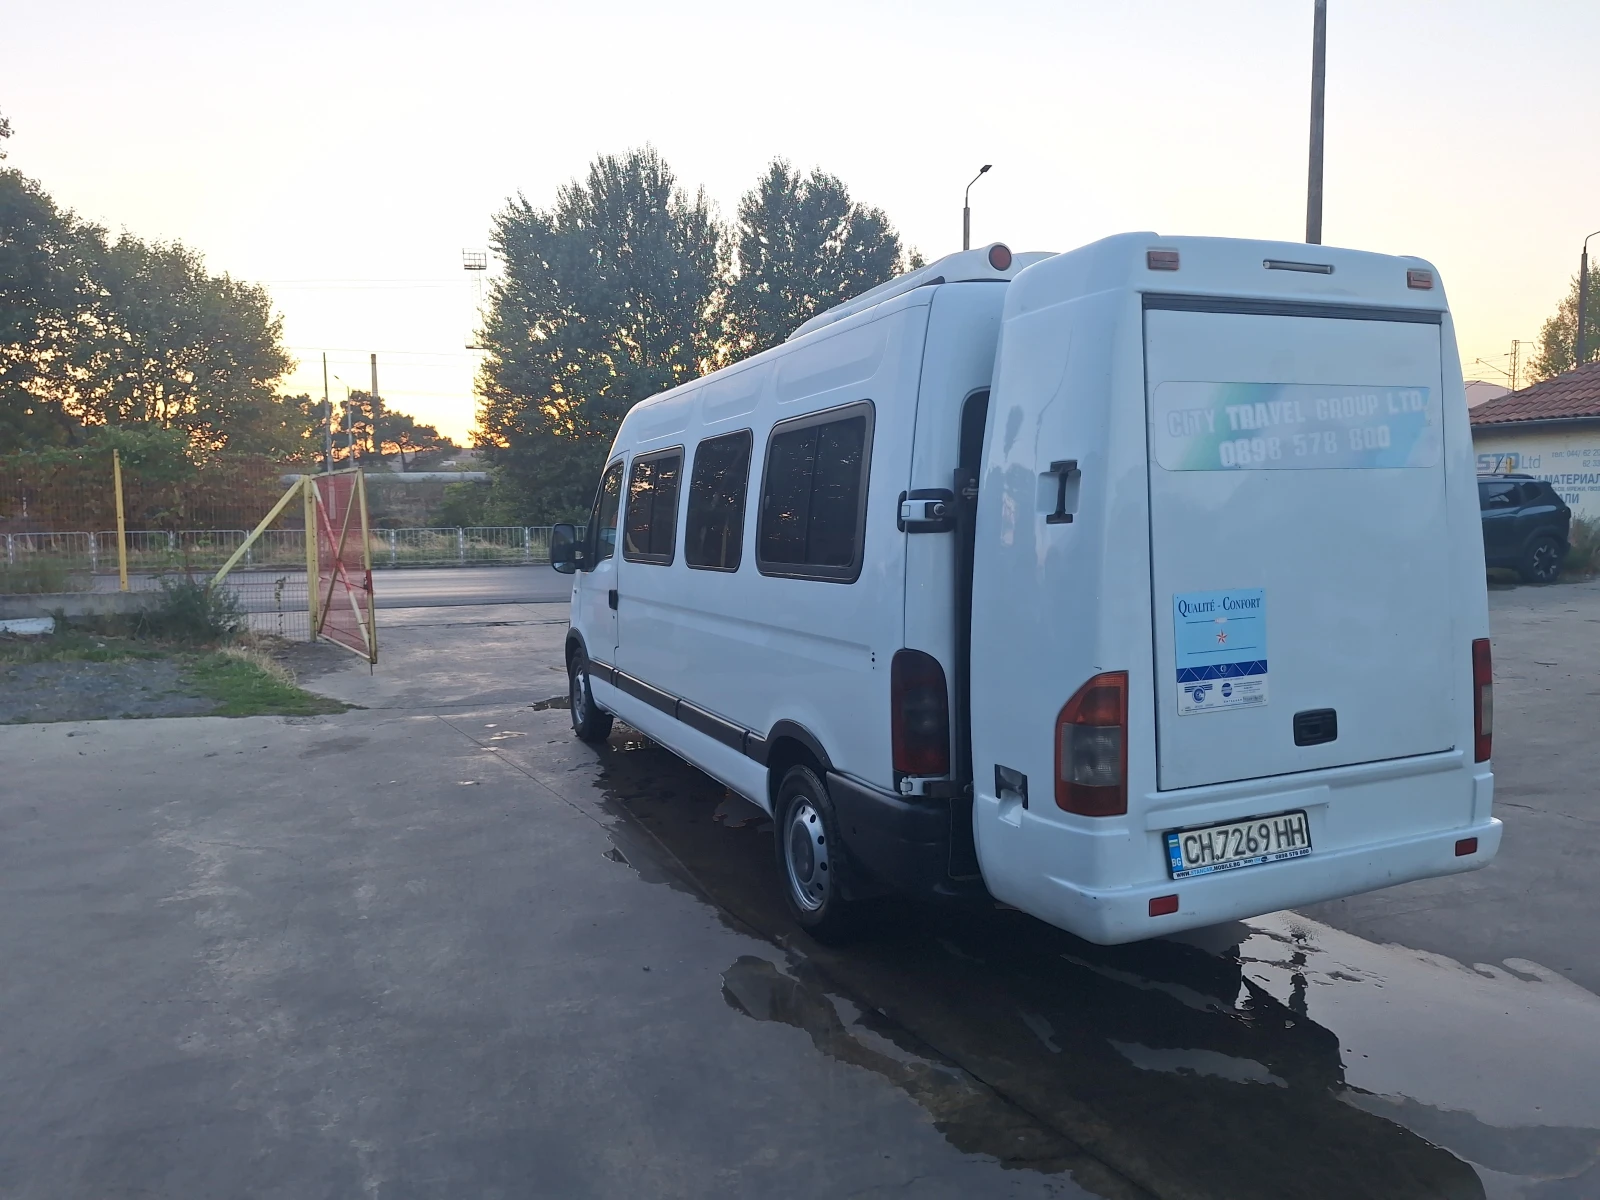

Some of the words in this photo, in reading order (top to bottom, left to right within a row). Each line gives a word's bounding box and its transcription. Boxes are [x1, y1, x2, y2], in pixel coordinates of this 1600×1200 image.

[1167, 407, 1215, 438] CITY
[1225, 400, 1306, 431] TRAVEL
[1316, 394, 1379, 421] GROUP
[1219, 436, 1282, 467] 0898
[1294, 431, 1338, 457] 578
[1521, 455, 1541, 469] Ltd
[1222, 596, 1260, 611] CONFORT
[1172, 858, 1182, 867] BG
